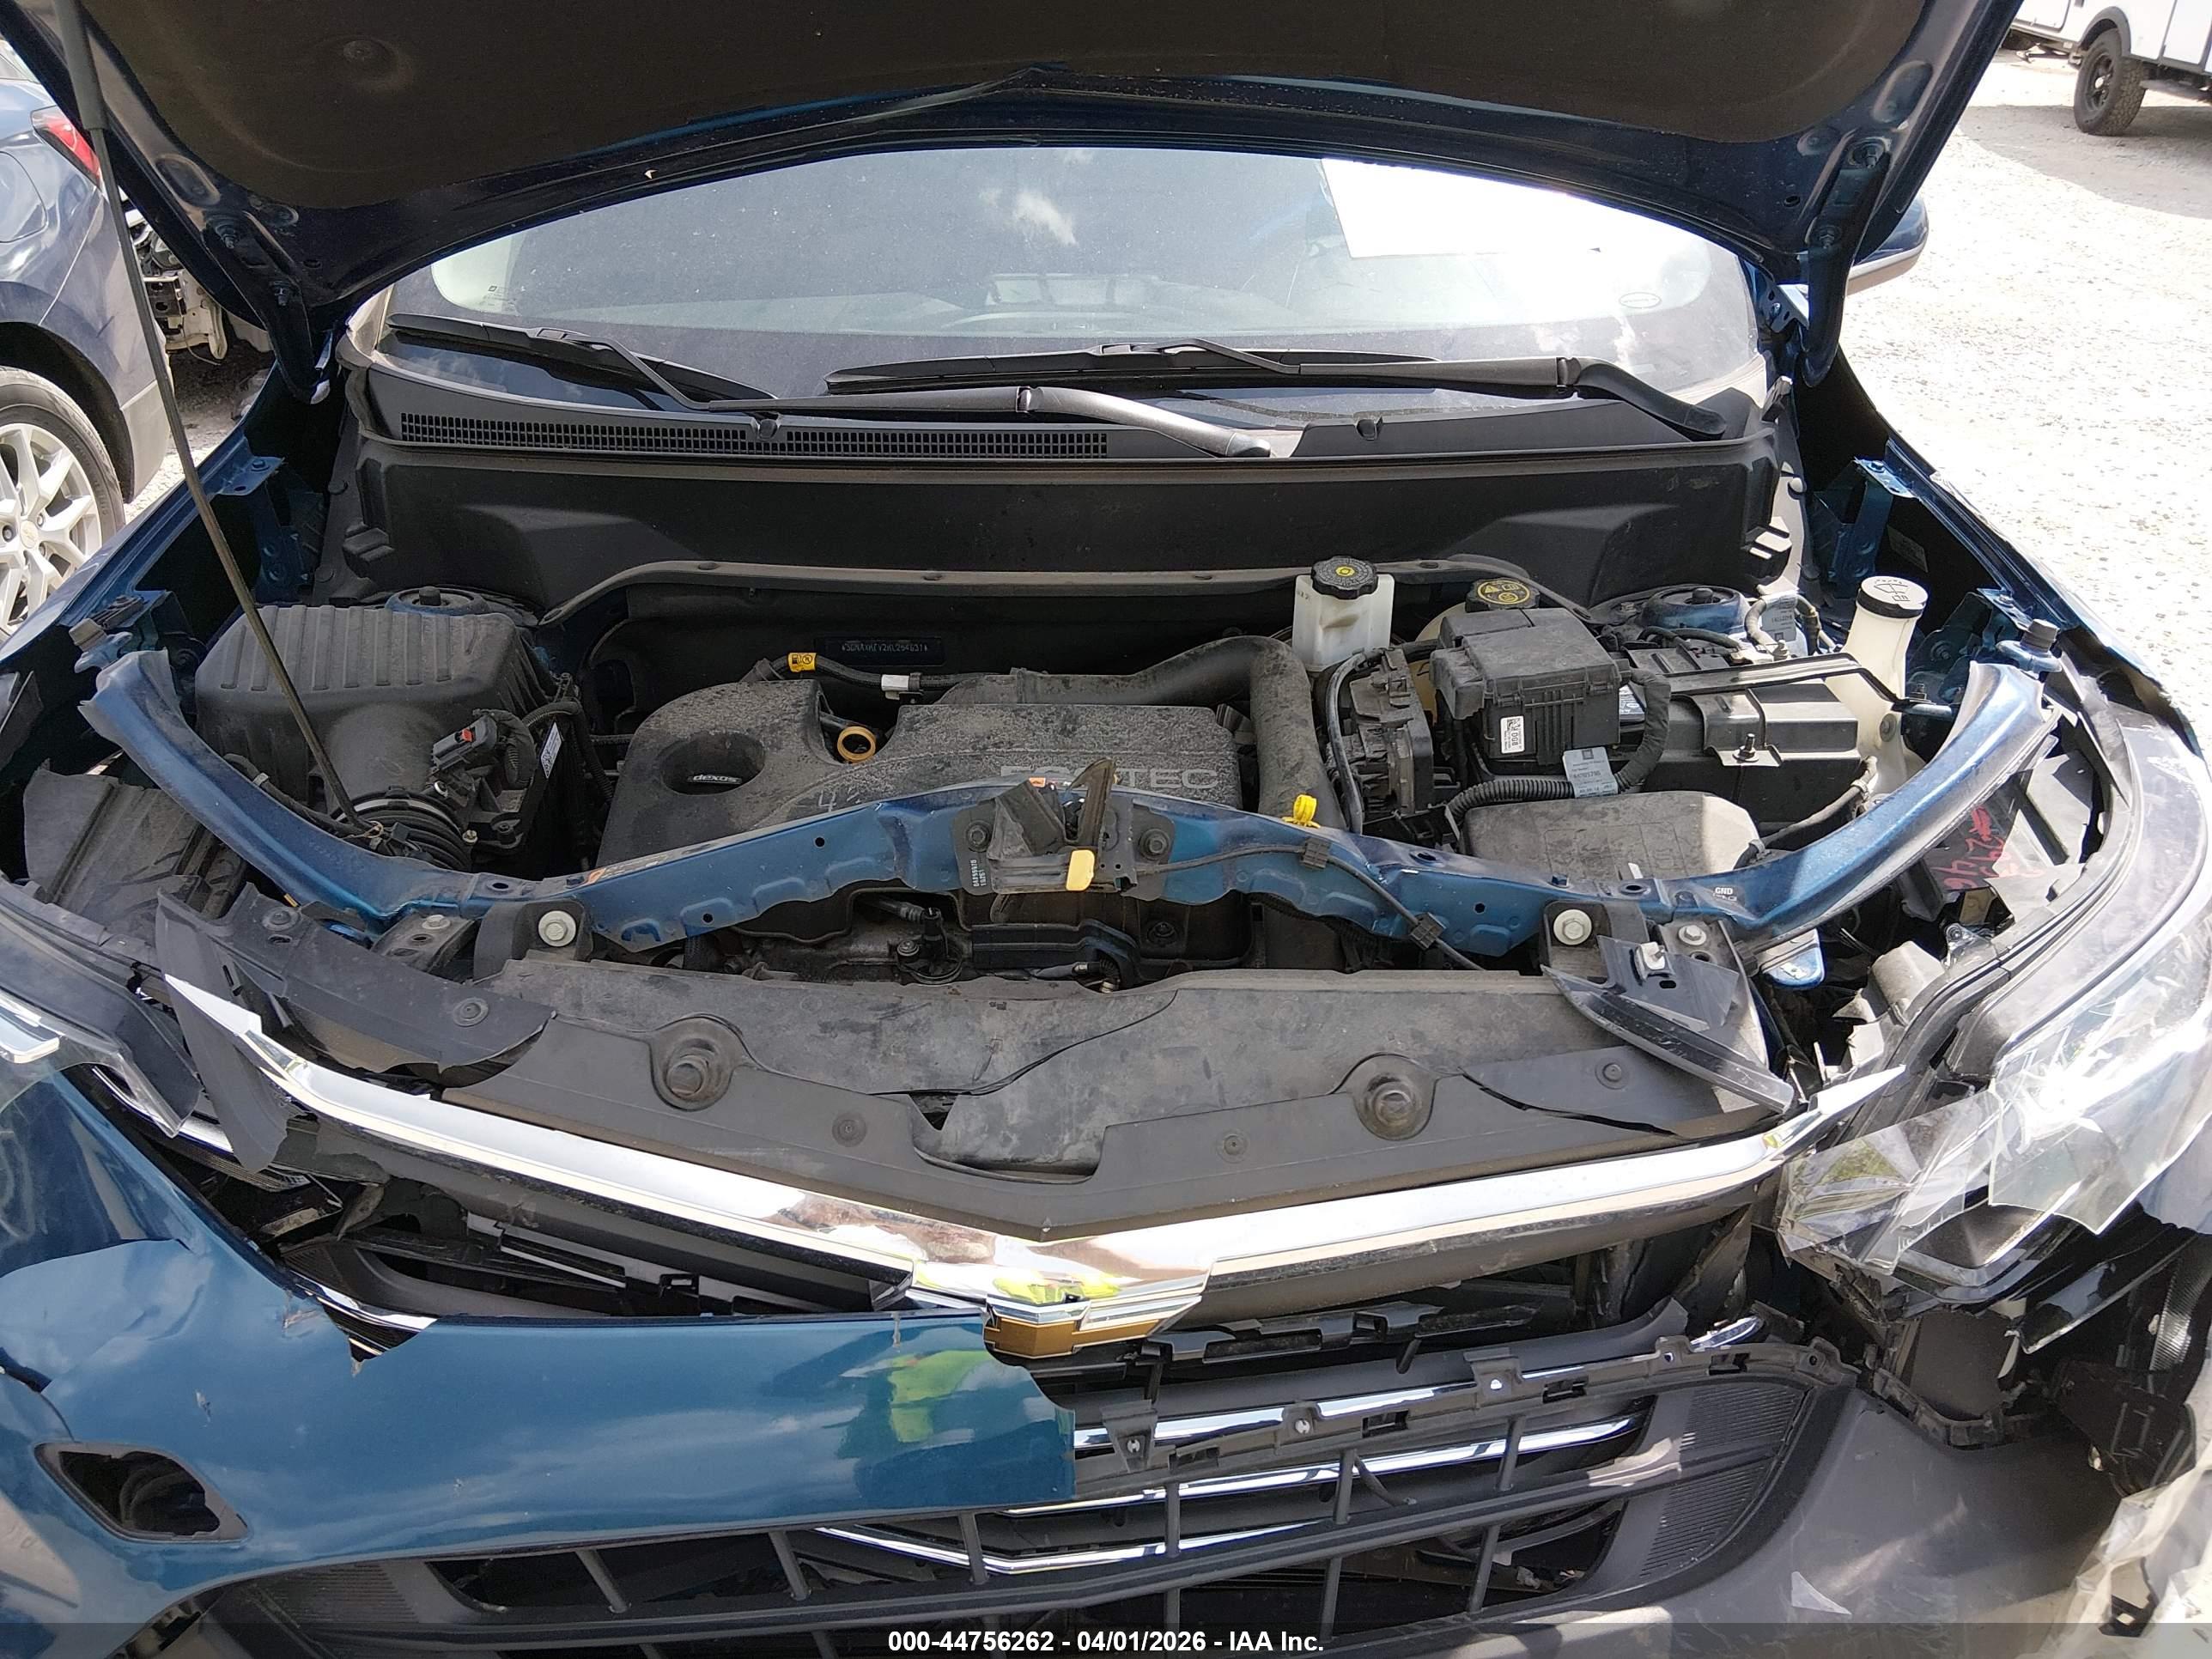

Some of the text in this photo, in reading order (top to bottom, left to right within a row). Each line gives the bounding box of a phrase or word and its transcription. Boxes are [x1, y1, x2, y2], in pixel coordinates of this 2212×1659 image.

[692, 773, 740, 783] dexos
[1001, 765, 1218, 789] TEC
[1715, 886, 1734, 896] GND
